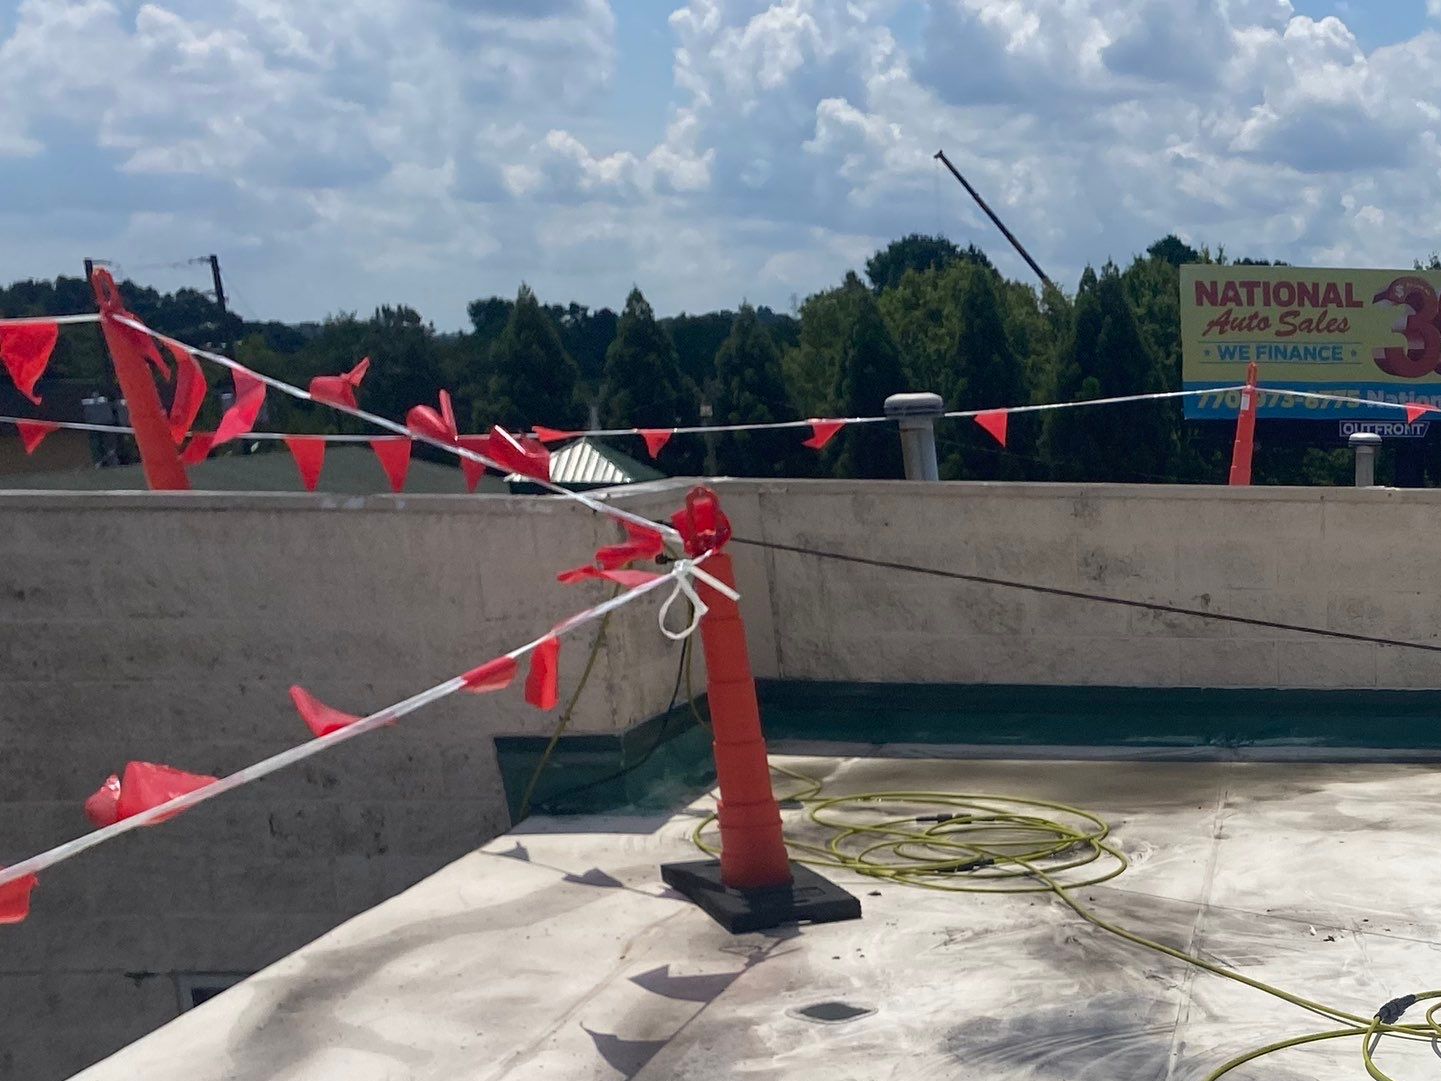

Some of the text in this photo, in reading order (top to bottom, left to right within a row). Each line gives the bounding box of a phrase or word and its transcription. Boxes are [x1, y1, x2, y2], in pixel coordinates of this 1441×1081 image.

[1194, 280, 1364, 308] NATIONAL
[1202, 308, 1350, 337] Auto Sales
[1217, 344, 1344, 361] WE FINANCE
[1342, 422, 1425, 435] OUTFRONT
